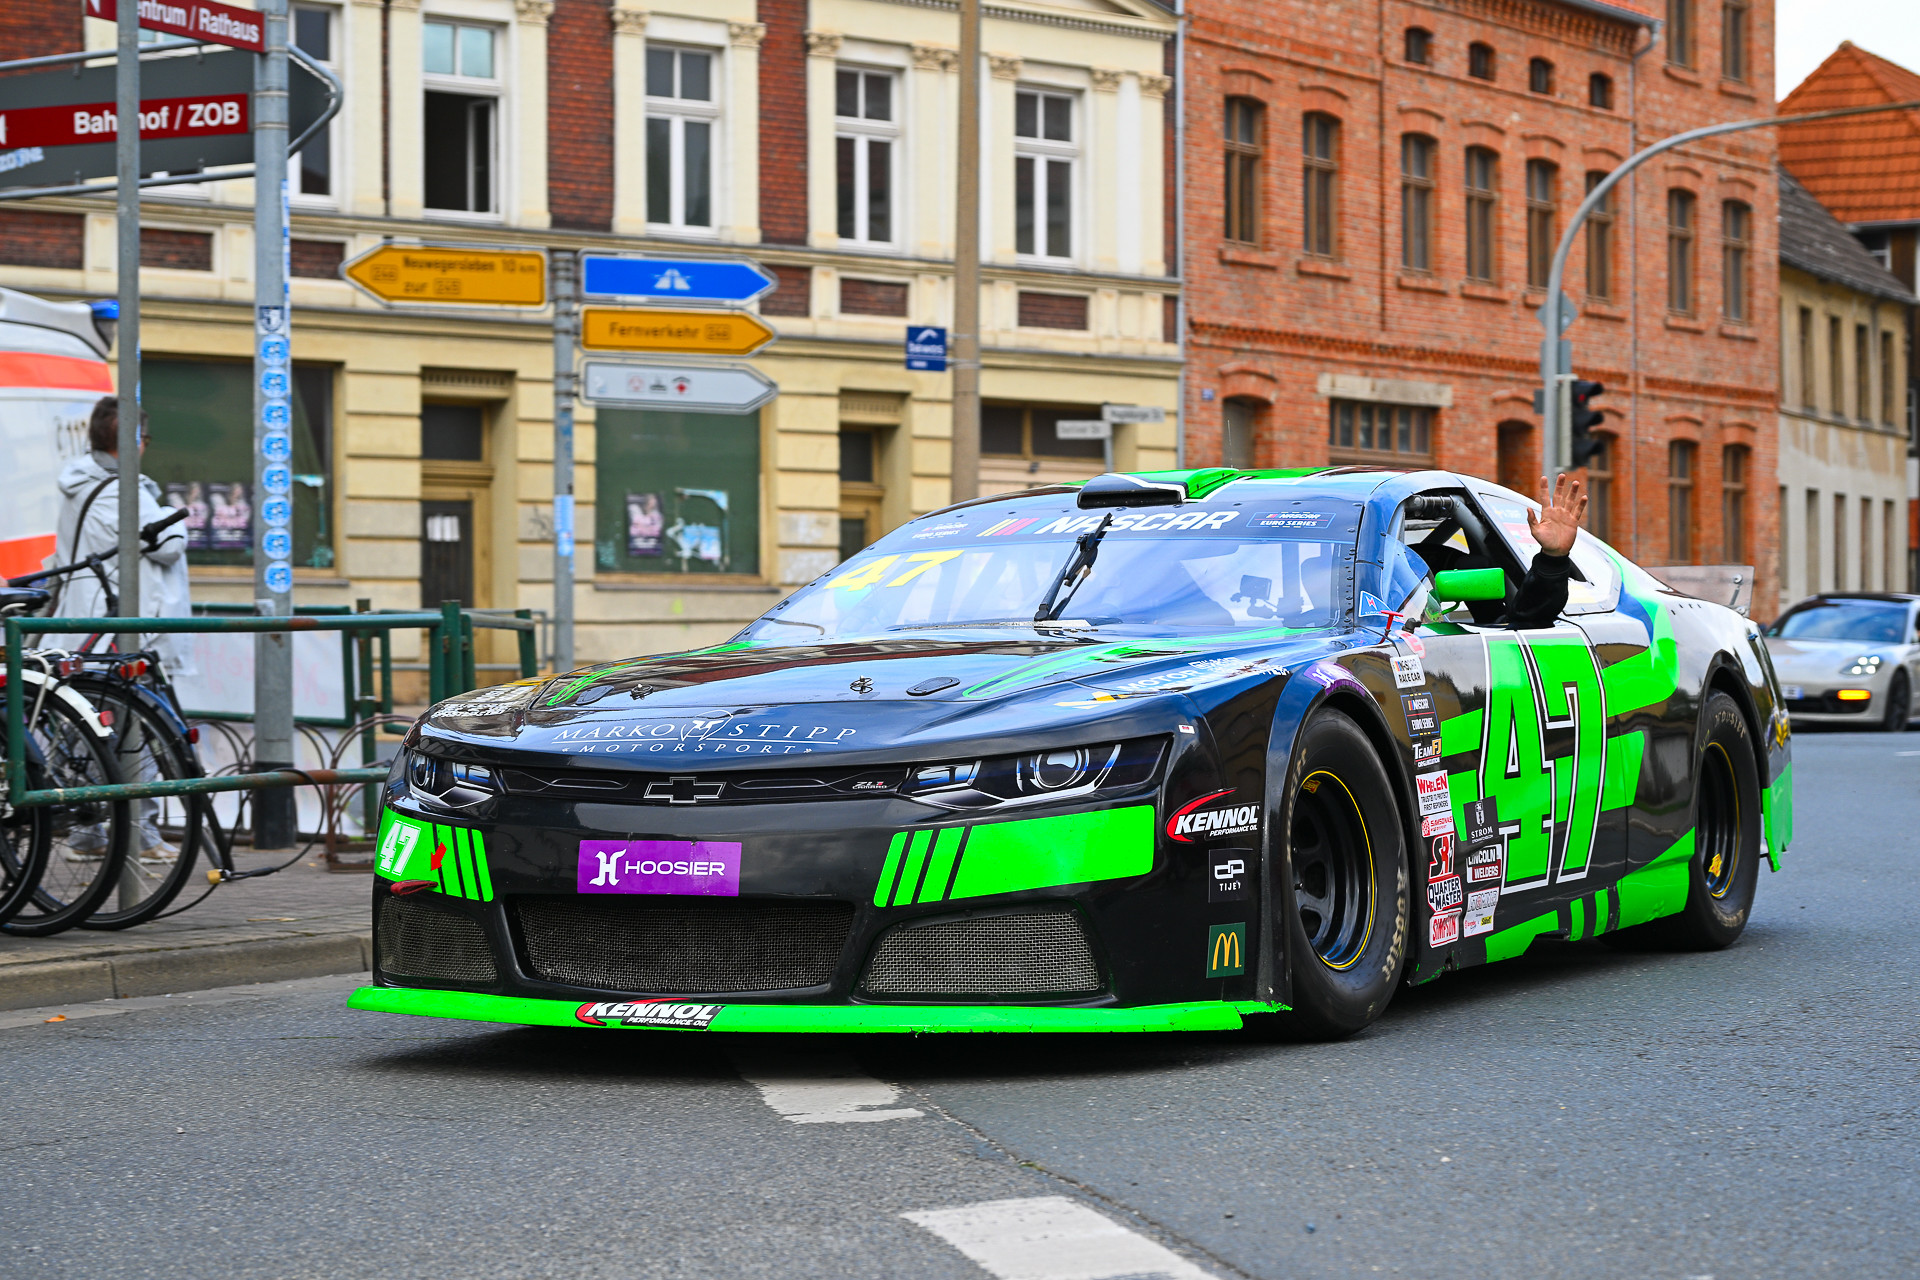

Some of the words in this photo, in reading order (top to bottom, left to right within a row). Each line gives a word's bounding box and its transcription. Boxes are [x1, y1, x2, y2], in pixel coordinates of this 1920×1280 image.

[199, 8, 260, 43] Rathaus
[188, 101, 241, 127] ZOB
[609, 321, 700, 340] Fernverkehr
[1034, 510, 1240, 536] NASCAR
[824, 550, 965, 592] 47
[1116, 669, 1199, 691] MOTOR
[553, 723, 676, 741] MARKO
[728, 723, 857, 741] STIPP
[578, 743, 797, 754] MOTORSPORT
[1479, 629, 1607, 895] 47
[1417, 773, 1448, 795] WHELEN
[1174, 805, 1259, 835] KENNOL
[1209, 826, 1249, 837] PERFORMANCE
[1471, 826, 1493, 839] STROM
[379, 819, 422, 876] 47
[1468, 848, 1496, 866] LINCOLN
[624, 859, 726, 877] HOOSIER
[1474, 865, 1499, 879] WELDERS
[1428, 878, 1460, 904] QUARTER
[1435, 890, 1461, 911] MASTER
[1432, 914, 1457, 942] SIMPSON
[585, 1002, 716, 1020] KENNOL
[627, 1016, 692, 1026] PERFORMANCE
[694, 1019, 708, 1027] OIL
